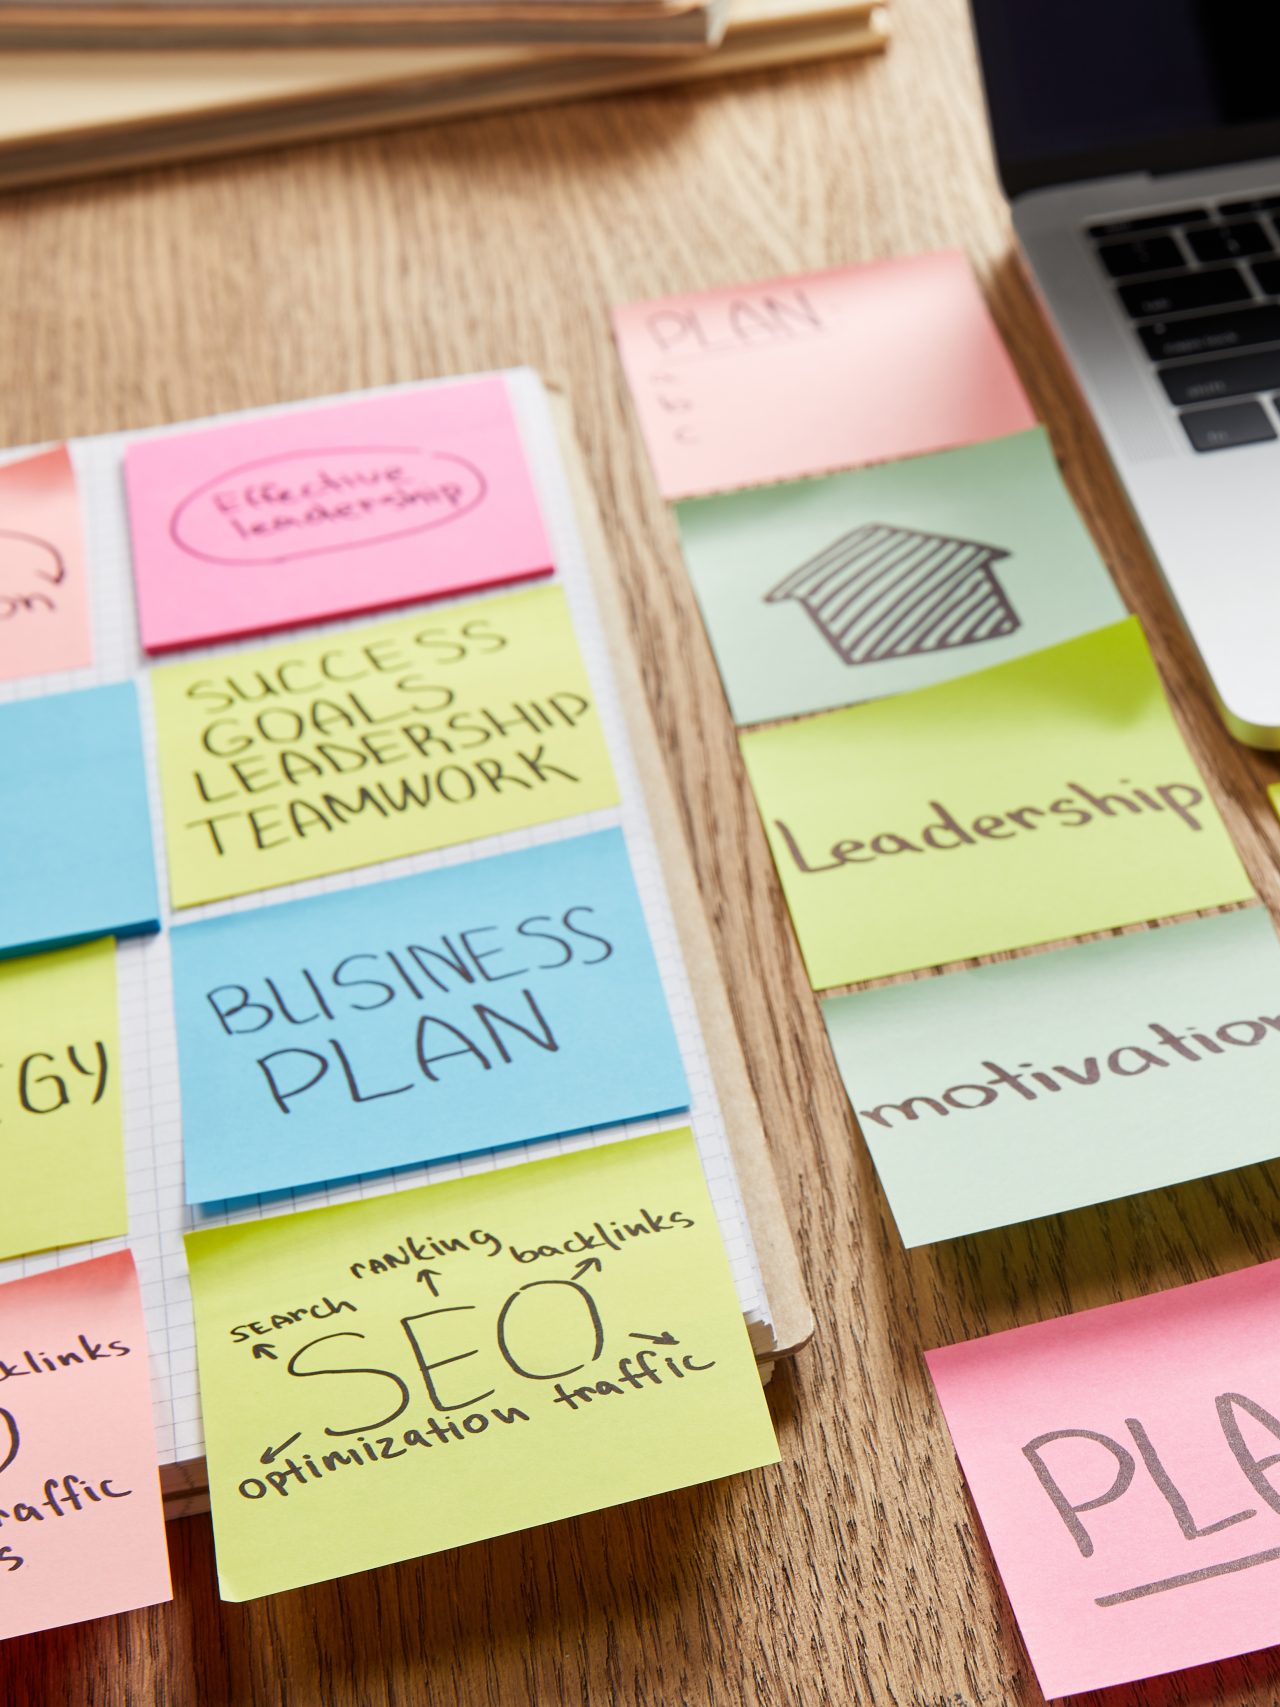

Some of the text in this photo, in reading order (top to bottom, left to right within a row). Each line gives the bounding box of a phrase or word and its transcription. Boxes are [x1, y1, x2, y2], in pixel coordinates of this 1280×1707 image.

[212, 466, 405, 513] Effective
[186, 619, 508, 714] SUCCESS
[194, 691, 591, 803] LEADERSHIP
[201, 673, 456, 759] GOALS
[185, 744, 582, 858] TEAMWORK
[775, 778, 1206, 875] Leadership
[206, 906, 614, 1035] BUSINESS
[0, 1040, 107, 1114] GY
[256, 988, 560, 1114] PLAN
[509, 1208, 696, 1263] backlinks
[287, 1279, 604, 1437] SEO
[552, 1347, 716, 1411] traffic
[238, 1405, 531, 1499] optimization
